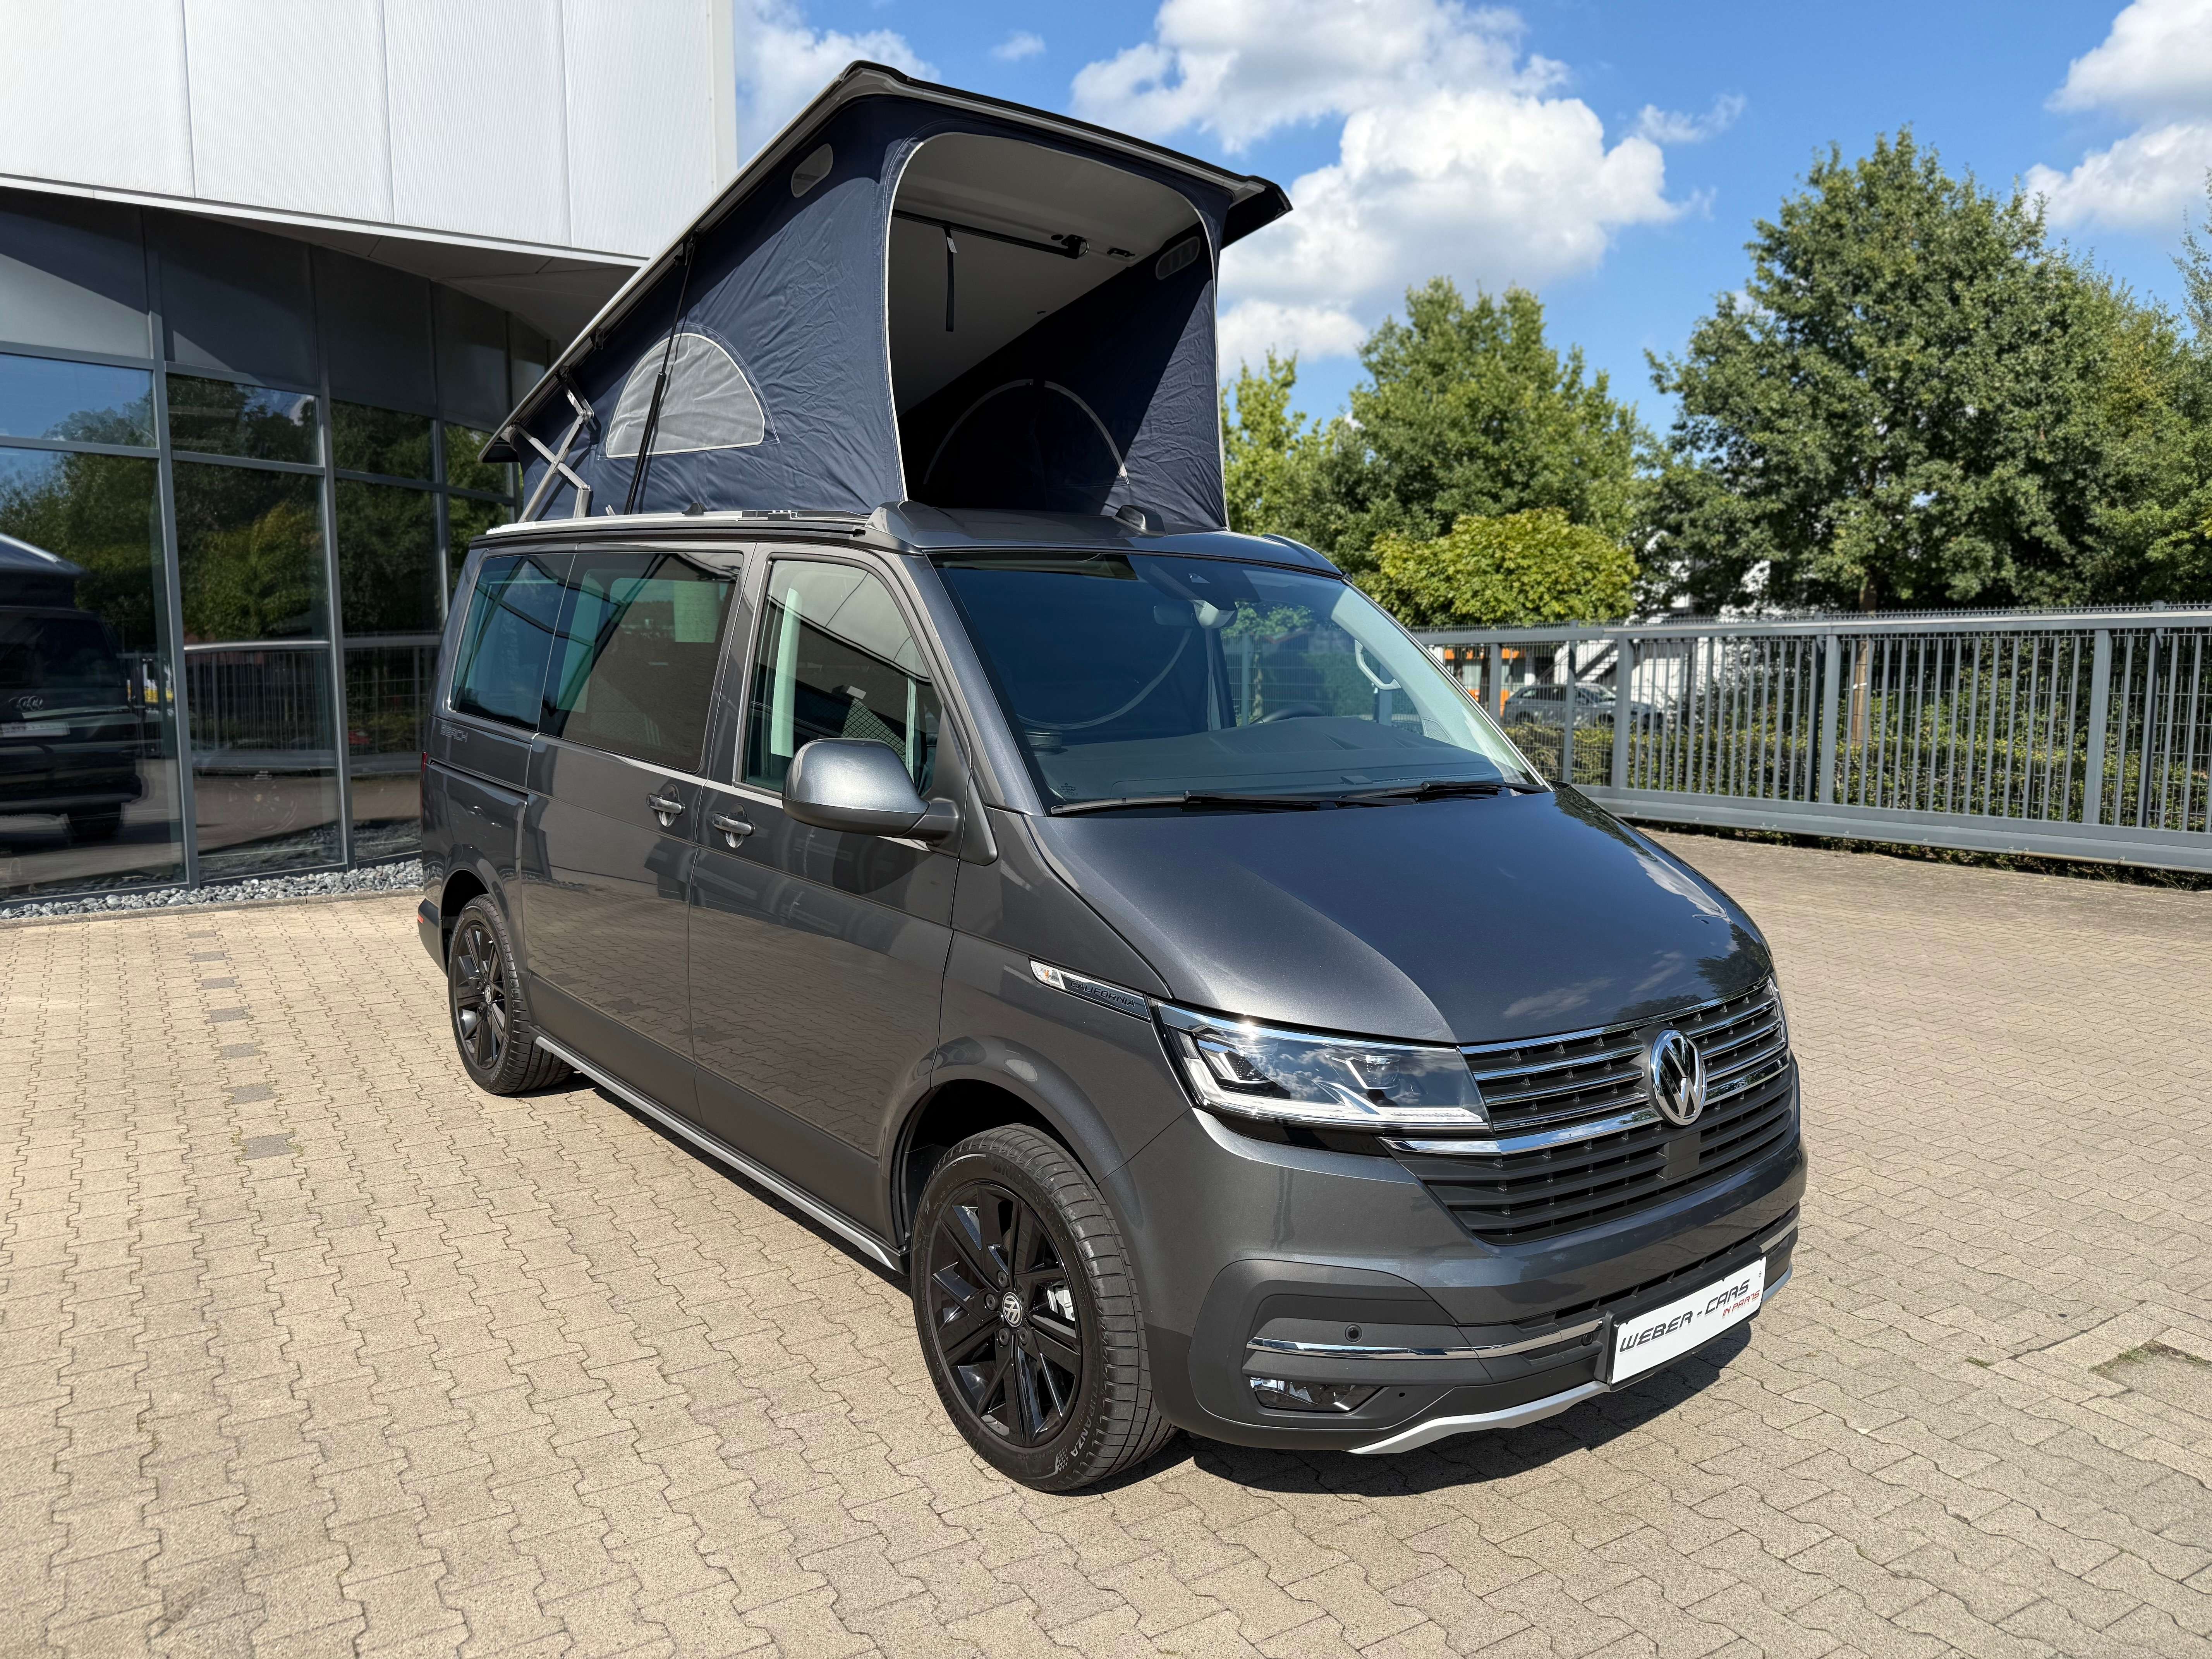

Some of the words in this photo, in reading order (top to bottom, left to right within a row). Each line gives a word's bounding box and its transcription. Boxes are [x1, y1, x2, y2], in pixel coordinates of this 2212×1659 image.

[440, 724, 468, 743] BEACH
[1070, 980, 1136, 1008] CALIFORNIA
[1619, 1310, 1693, 1353] WEBER
[1705, 1278, 1750, 1316] CARS
[1723, 1306, 1731, 1317] IN
[1732, 1290, 1760, 1312] PARTS
[1070, 1381, 1099, 1457] TURANZA
